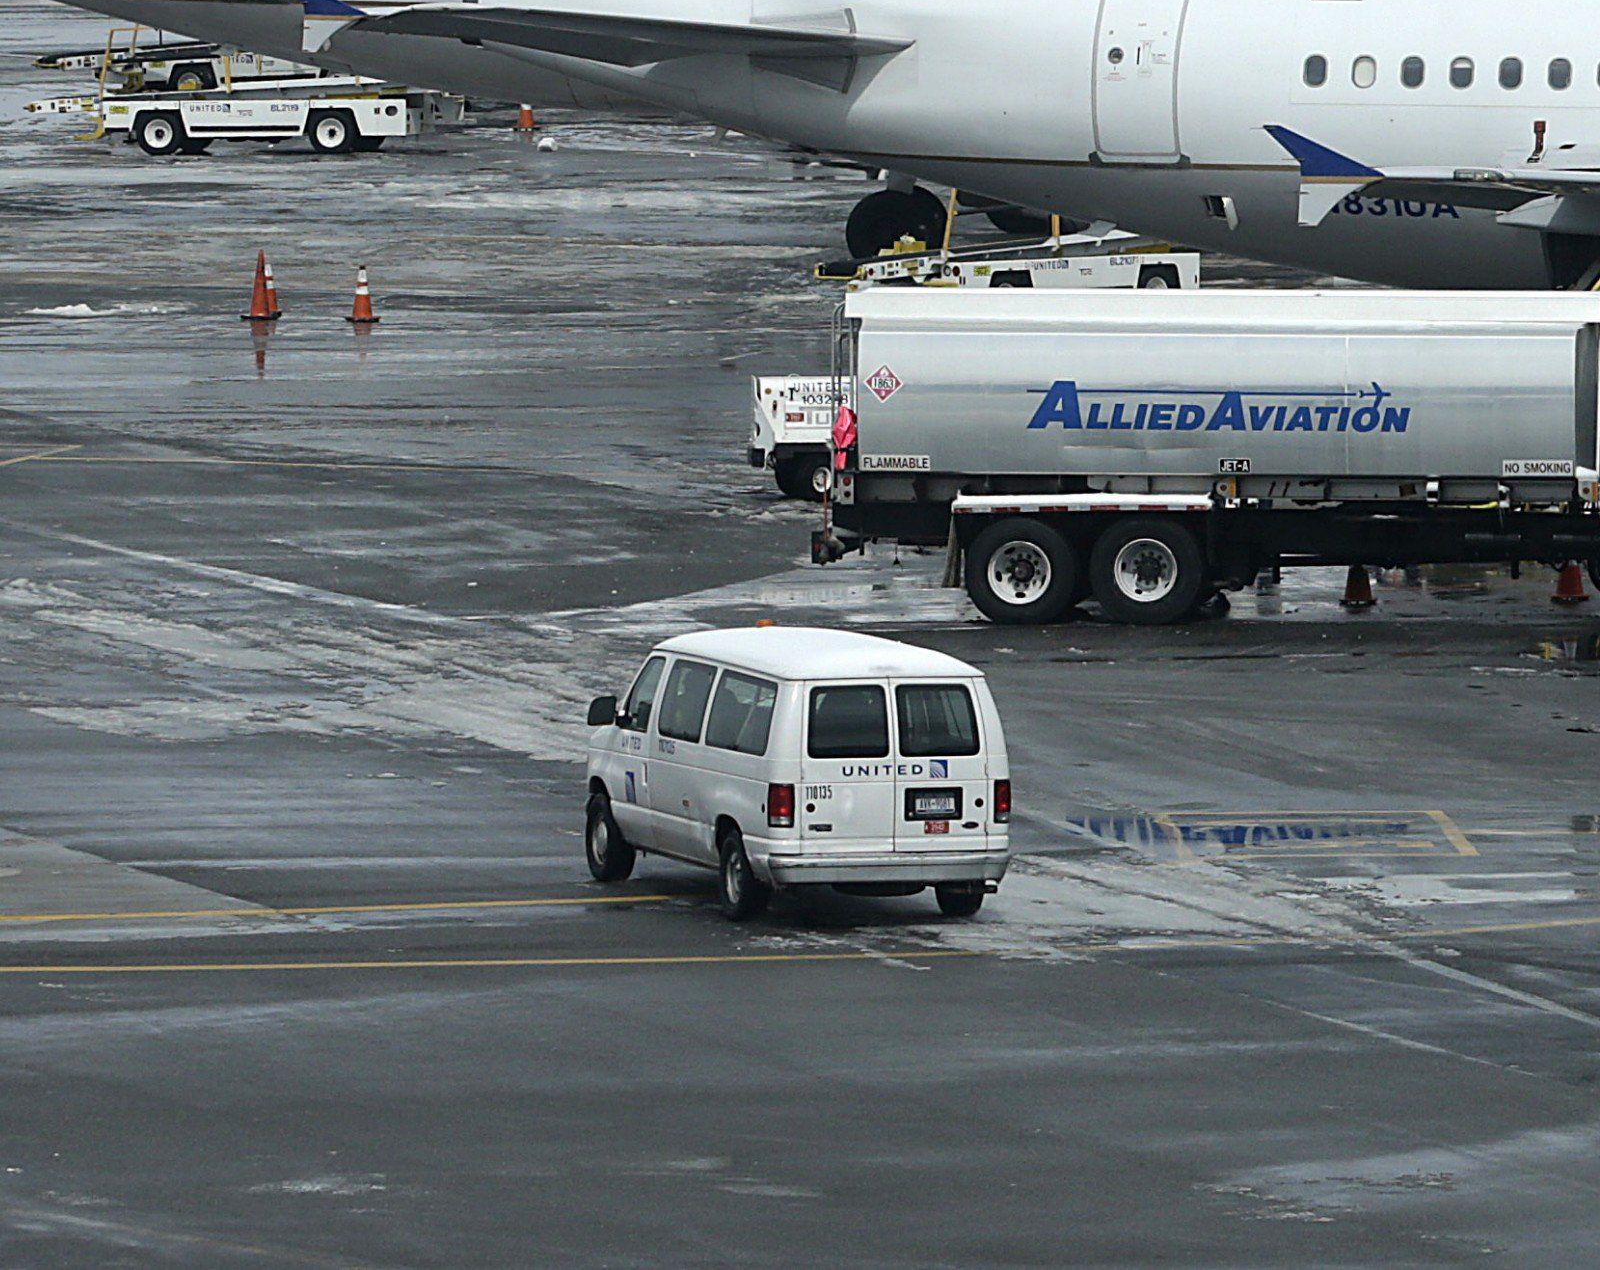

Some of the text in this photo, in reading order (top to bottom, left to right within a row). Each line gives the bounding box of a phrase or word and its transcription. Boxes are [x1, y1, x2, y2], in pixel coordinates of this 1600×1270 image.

[863, 457, 929, 469] FLAMMABLE
[1221, 460, 1249, 471] JET-A
[1504, 463, 1571, 473] NO SMOKING
[842, 764, 923, 777] UNITED
